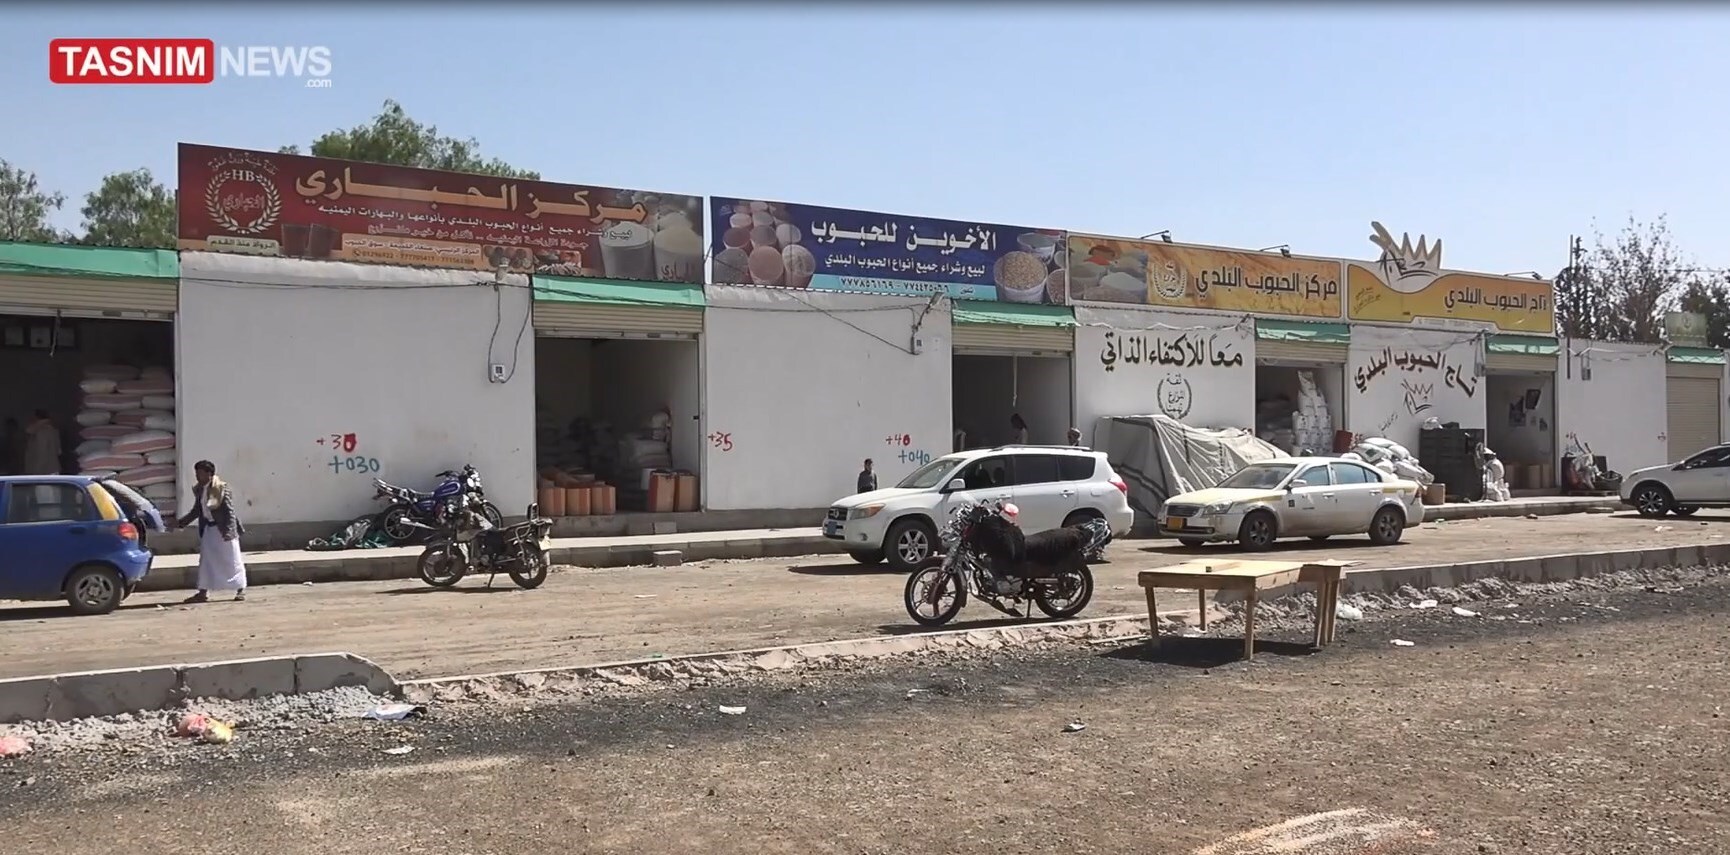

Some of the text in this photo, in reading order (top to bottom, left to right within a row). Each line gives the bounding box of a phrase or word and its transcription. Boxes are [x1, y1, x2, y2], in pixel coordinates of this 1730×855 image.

[232, 169, 255, 181] HB
[525, 190, 649, 224] مركز
[485, 220, 519, 232] الحبوب
[549, 226, 574, 236] جميع
[811, 219, 997, 255] الأخوين للحبوب
[824, 253, 986, 278] لبيع وشراء جميع أنواع الحبوب البلدي
[1195, 266, 1242, 298] البلدي
[1245, 272, 1300, 296] الحبوب
[1305, 274, 1338, 301] مركز
[1444, 287, 1481, 313] البلدي
[1484, 292, 1527, 311] الحبوب
[1100, 332, 1147, 372] الذاتي
[1394, 351, 1447, 373] الحبوب
[1354, 345, 1393, 394] البلدي
[707, 431, 733, 452] +35
[328, 455, 380, 474] +030
[898, 449, 930, 465] +040
